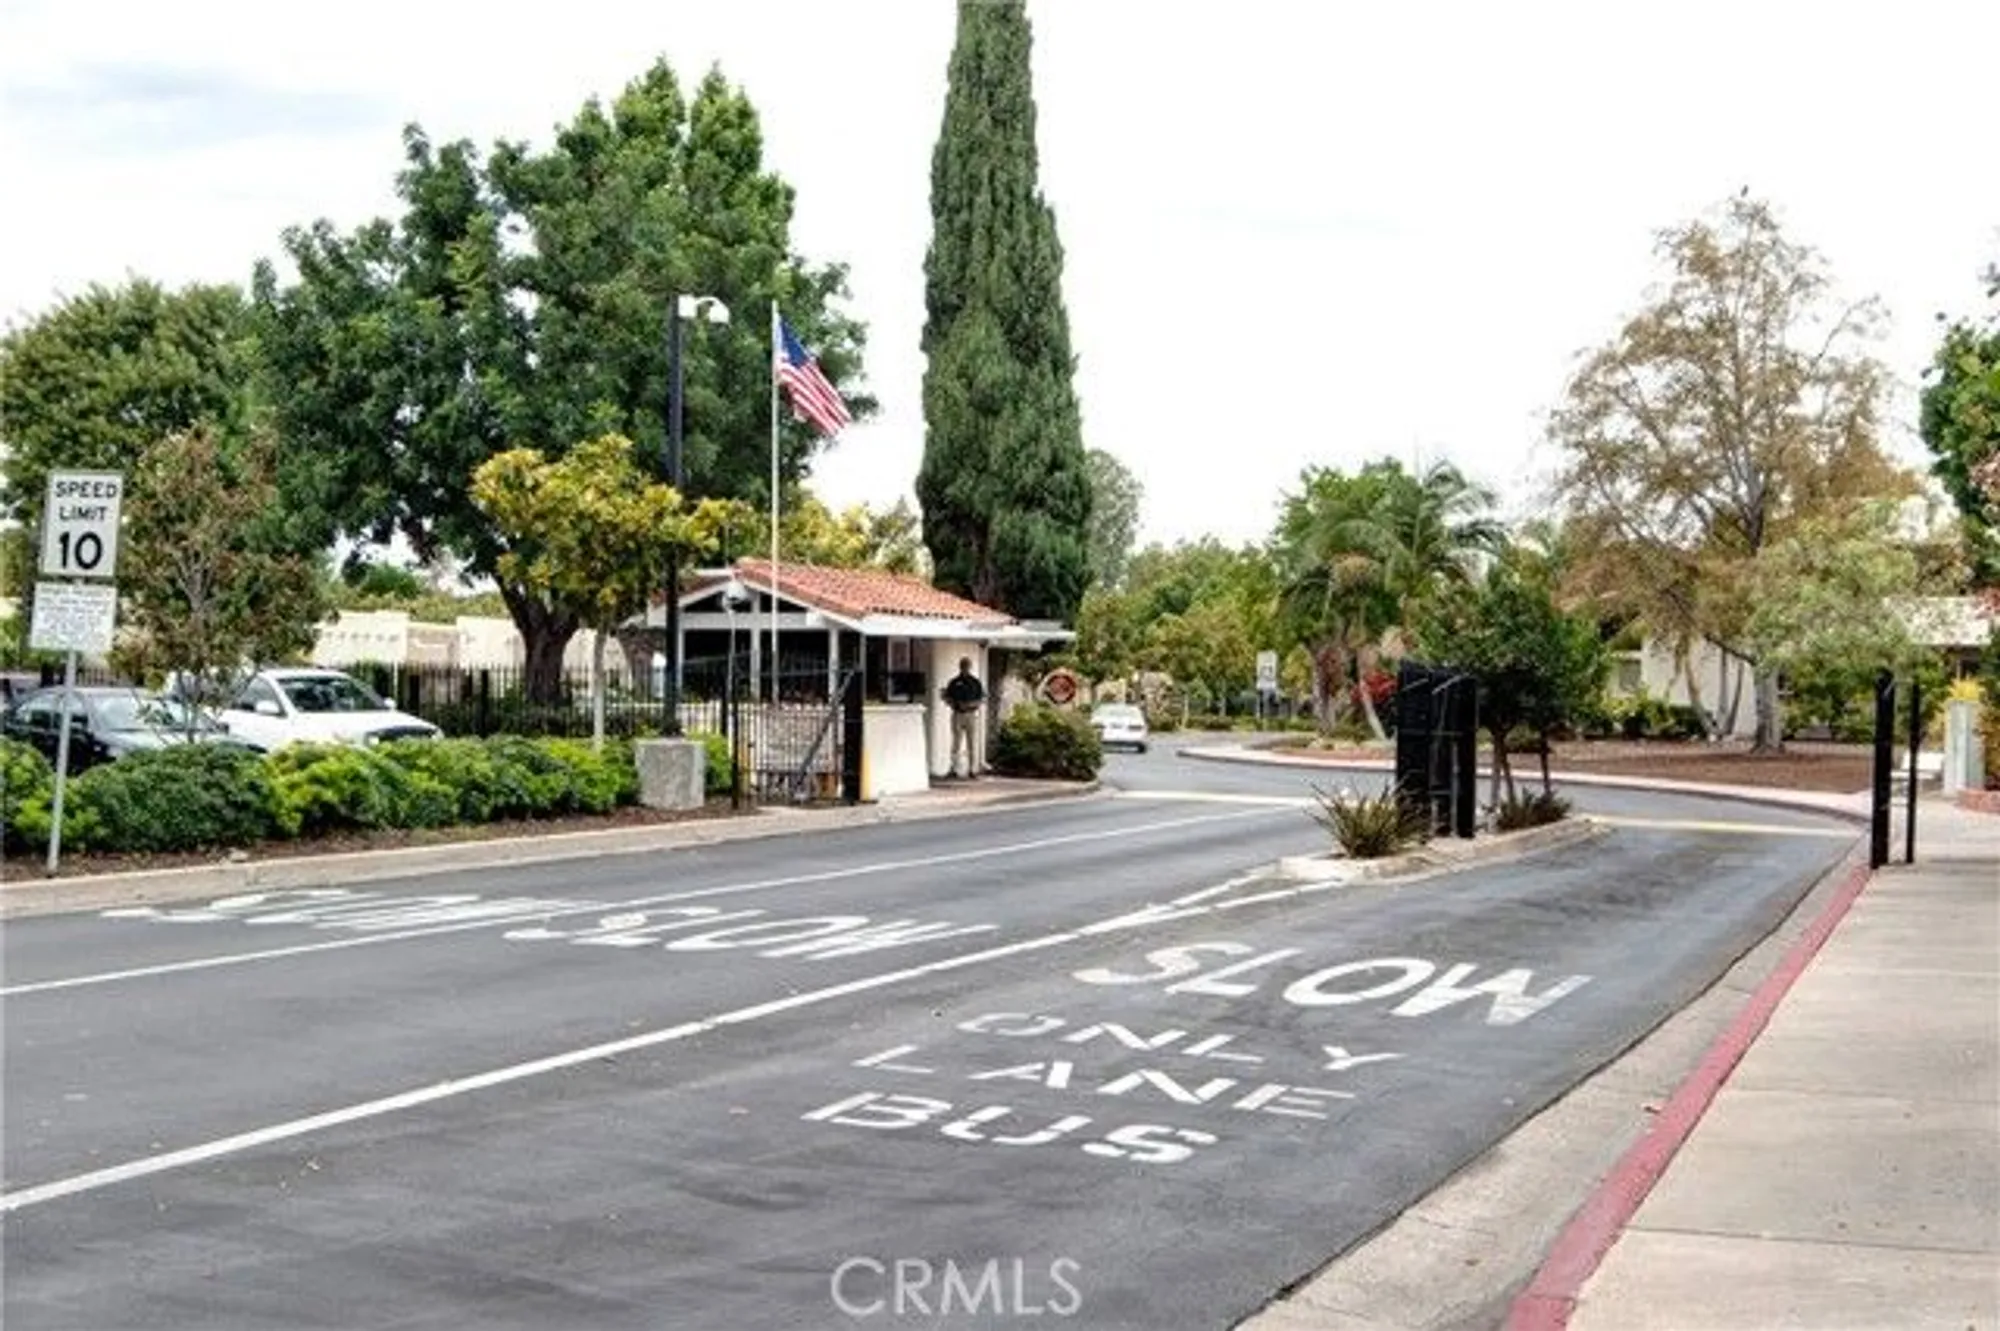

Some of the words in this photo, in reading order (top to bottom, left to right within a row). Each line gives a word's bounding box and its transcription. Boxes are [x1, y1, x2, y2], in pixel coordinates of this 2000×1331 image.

[56, 481, 118, 498] SPEED
[59, 506, 108, 521] LIMIT
[59, 531, 103, 570] 10
[503, 906, 998, 961] SLOW
[1073, 941, 1593, 1026] SLOW
[957, 1011, 1407, 1071] ONLY
[851, 1044, 1356, 1120] LANE
[801, 1091, 1218, 1165] BUS
